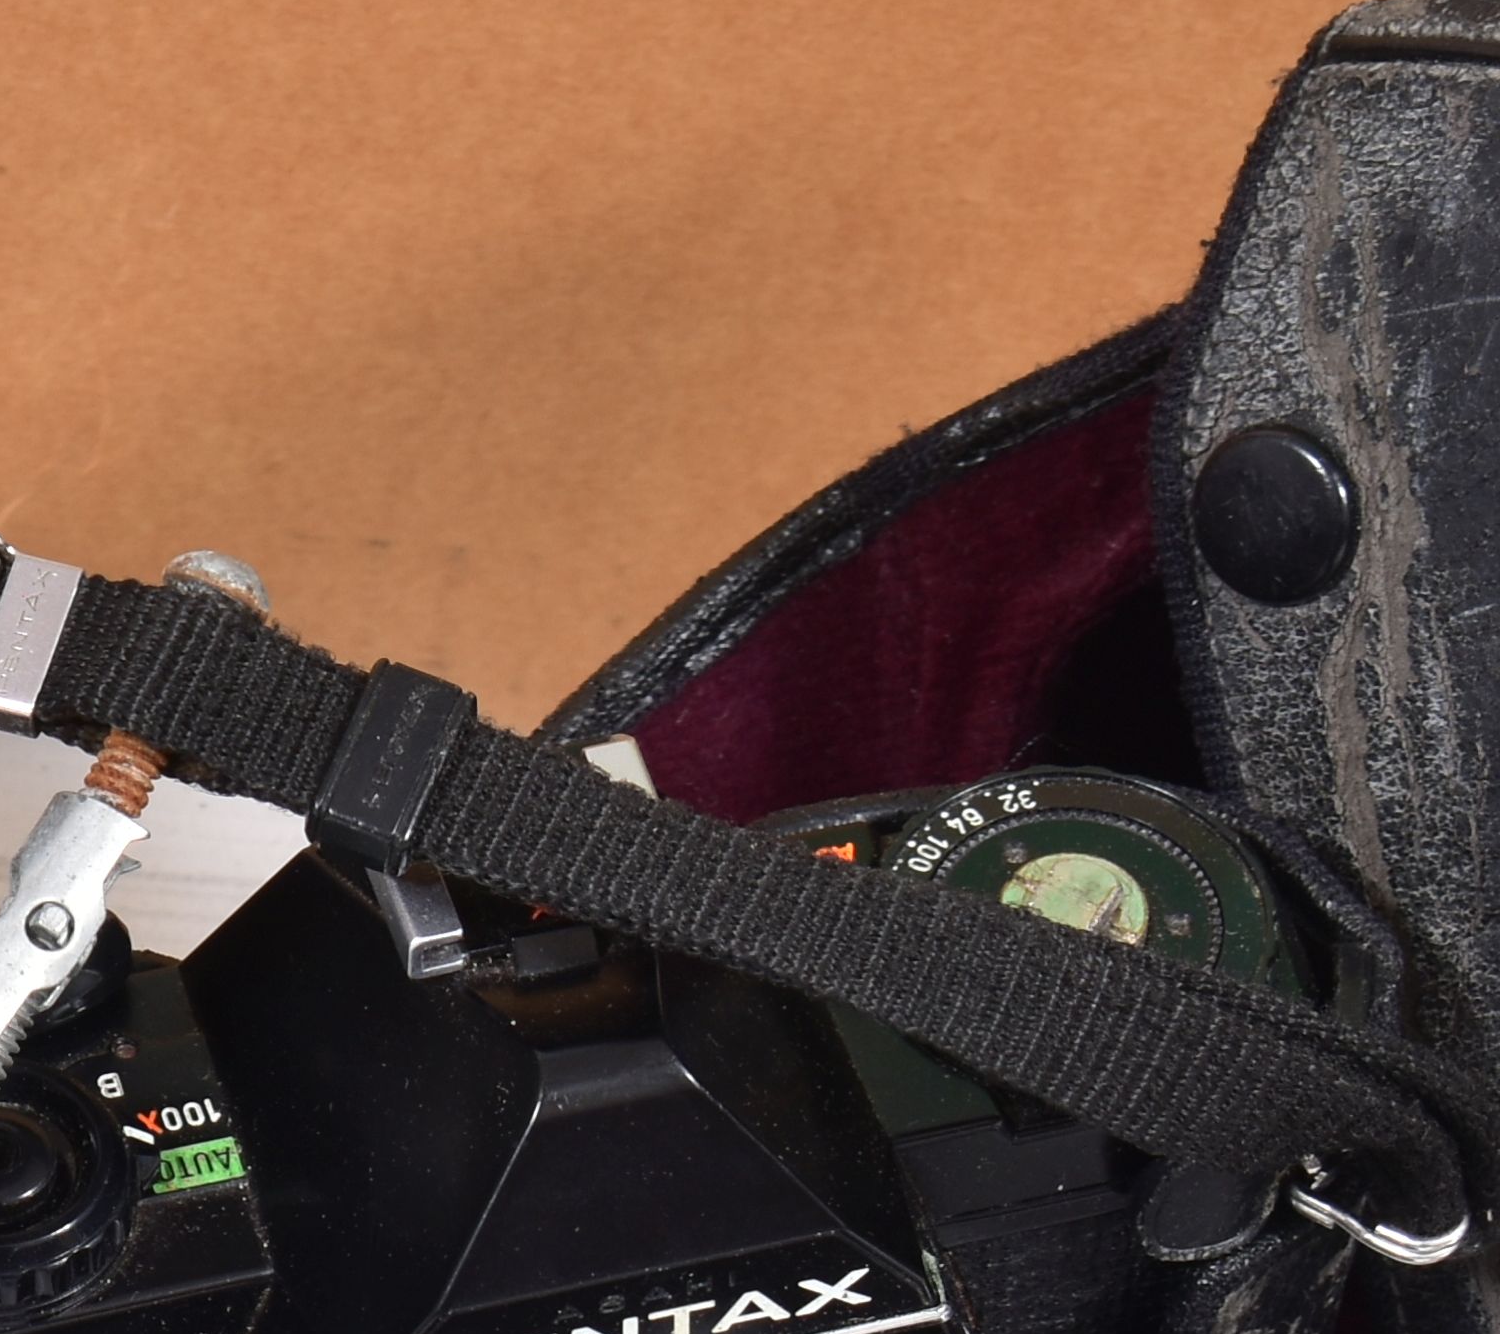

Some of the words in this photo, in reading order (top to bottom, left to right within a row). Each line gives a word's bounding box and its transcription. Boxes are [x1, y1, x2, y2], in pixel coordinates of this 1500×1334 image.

[997, 789, 1037, 813] 32
[946, 808, 985, 835] 64
[907, 835, 950, 873] 100
[96, 1071, 125, 1099] B
[159, 1147, 232, 1183] AUTO
